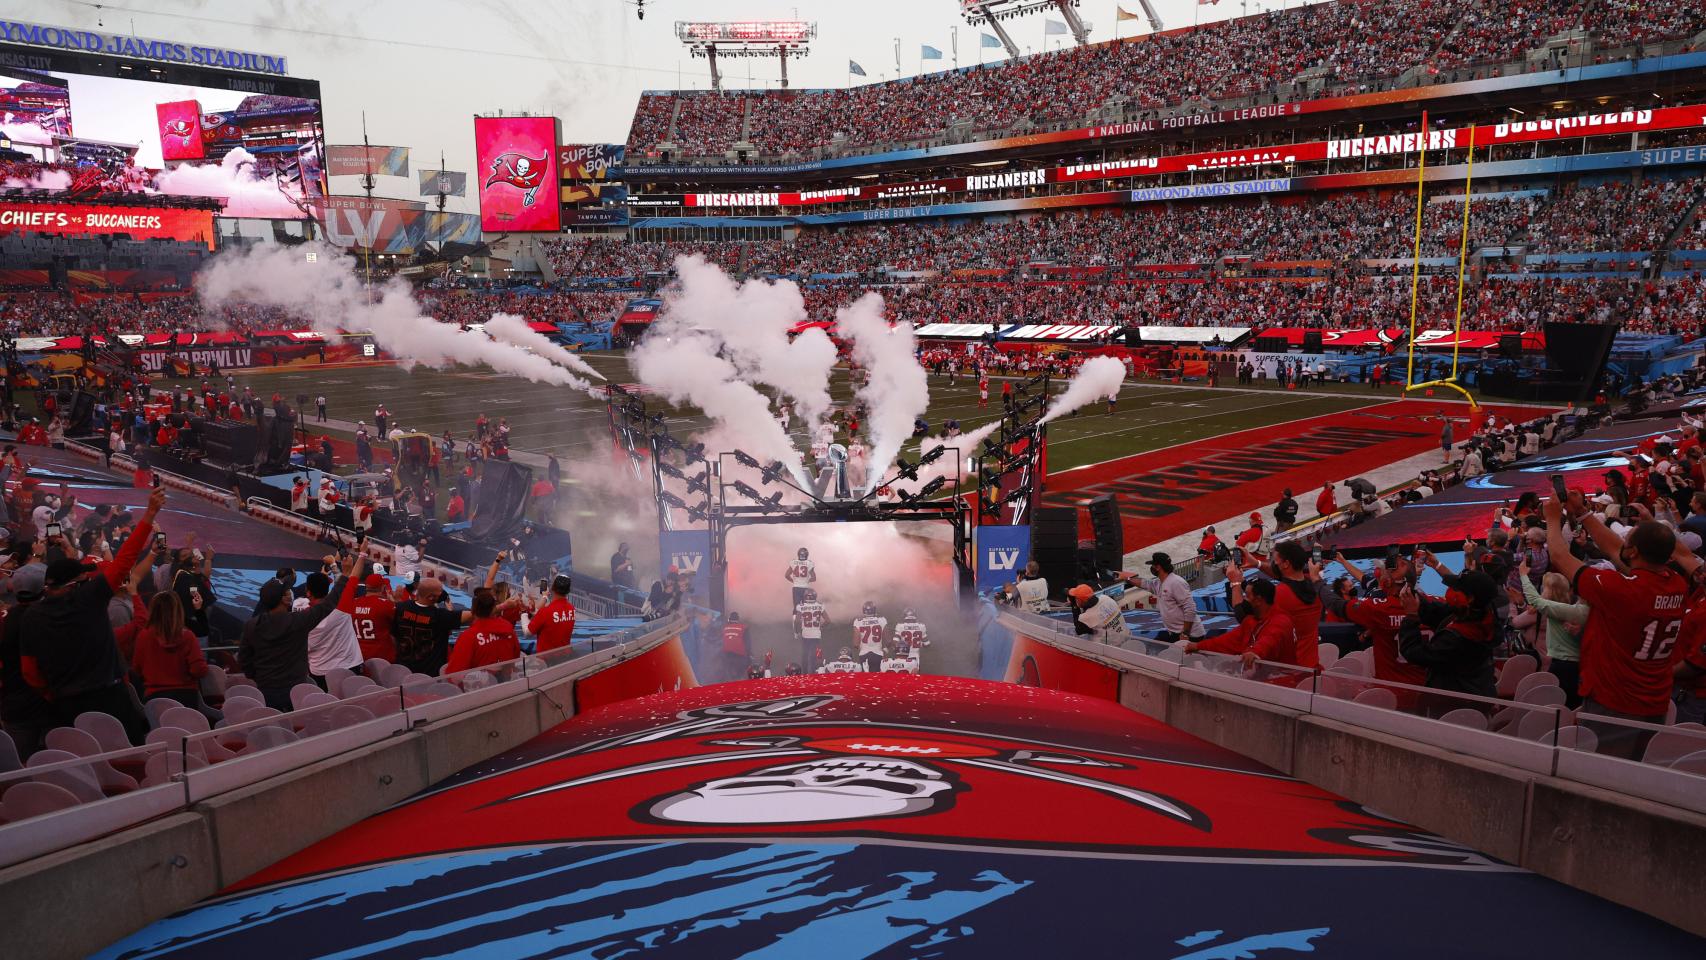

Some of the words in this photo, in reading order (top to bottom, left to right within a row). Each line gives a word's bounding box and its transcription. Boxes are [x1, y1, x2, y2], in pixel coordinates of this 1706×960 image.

[0, 21, 103, 52] YMOND
[107, 36, 186, 63] JAMES
[190, 46, 285, 75] STADIUM
[29, 55, 52, 70] CITY
[227, 78, 257, 92] TAMPA
[259, 80, 276, 94] BAY
[1101, 117, 1154, 136] NATIONAL
[1162, 112, 1225, 129] FOOTBALL
[1234, 105, 1286, 121] LEAGUE
[1327, 129, 1456, 159] BUCCANEERS
[561, 145, 603, 164] SUPER
[1203, 157, 1246, 165] TAMPA
[1254, 153, 1279, 161] BAY
[586, 155, 621, 172] BOWL
[967, 169, 1045, 190] BUCCANEERS
[1132, 186, 1190, 201] RAYMOND
[1191, 182, 1231, 197] JAMES
[1233, 179, 1288, 195] STADIUM
[697, 193, 779, 206] BUCCANEERS
[1, 211, 68, 226] CHIEFS
[86, 214, 161, 228] BUCCANEERS
[864, 211, 890, 219] SUPER
[893, 209, 916, 217] BOWL
[324, 208, 387, 248] LV
[236, 348, 251, 366] LV
[1283, 355, 1303, 363] BOWL
[672, 555, 703, 575] LV
[989, 551, 1019, 570] LV
[793, 565, 808, 577] 43
[355, 606, 371, 614] BRADY
[1654, 595, 1684, 609] BRADY
[803, 611, 821, 628] 23
[354, 618, 375, 640] 12
[859, 625, 882, 644] 79
[901, 631, 922, 648] 32
[1634, 620, 1682, 660] 12
